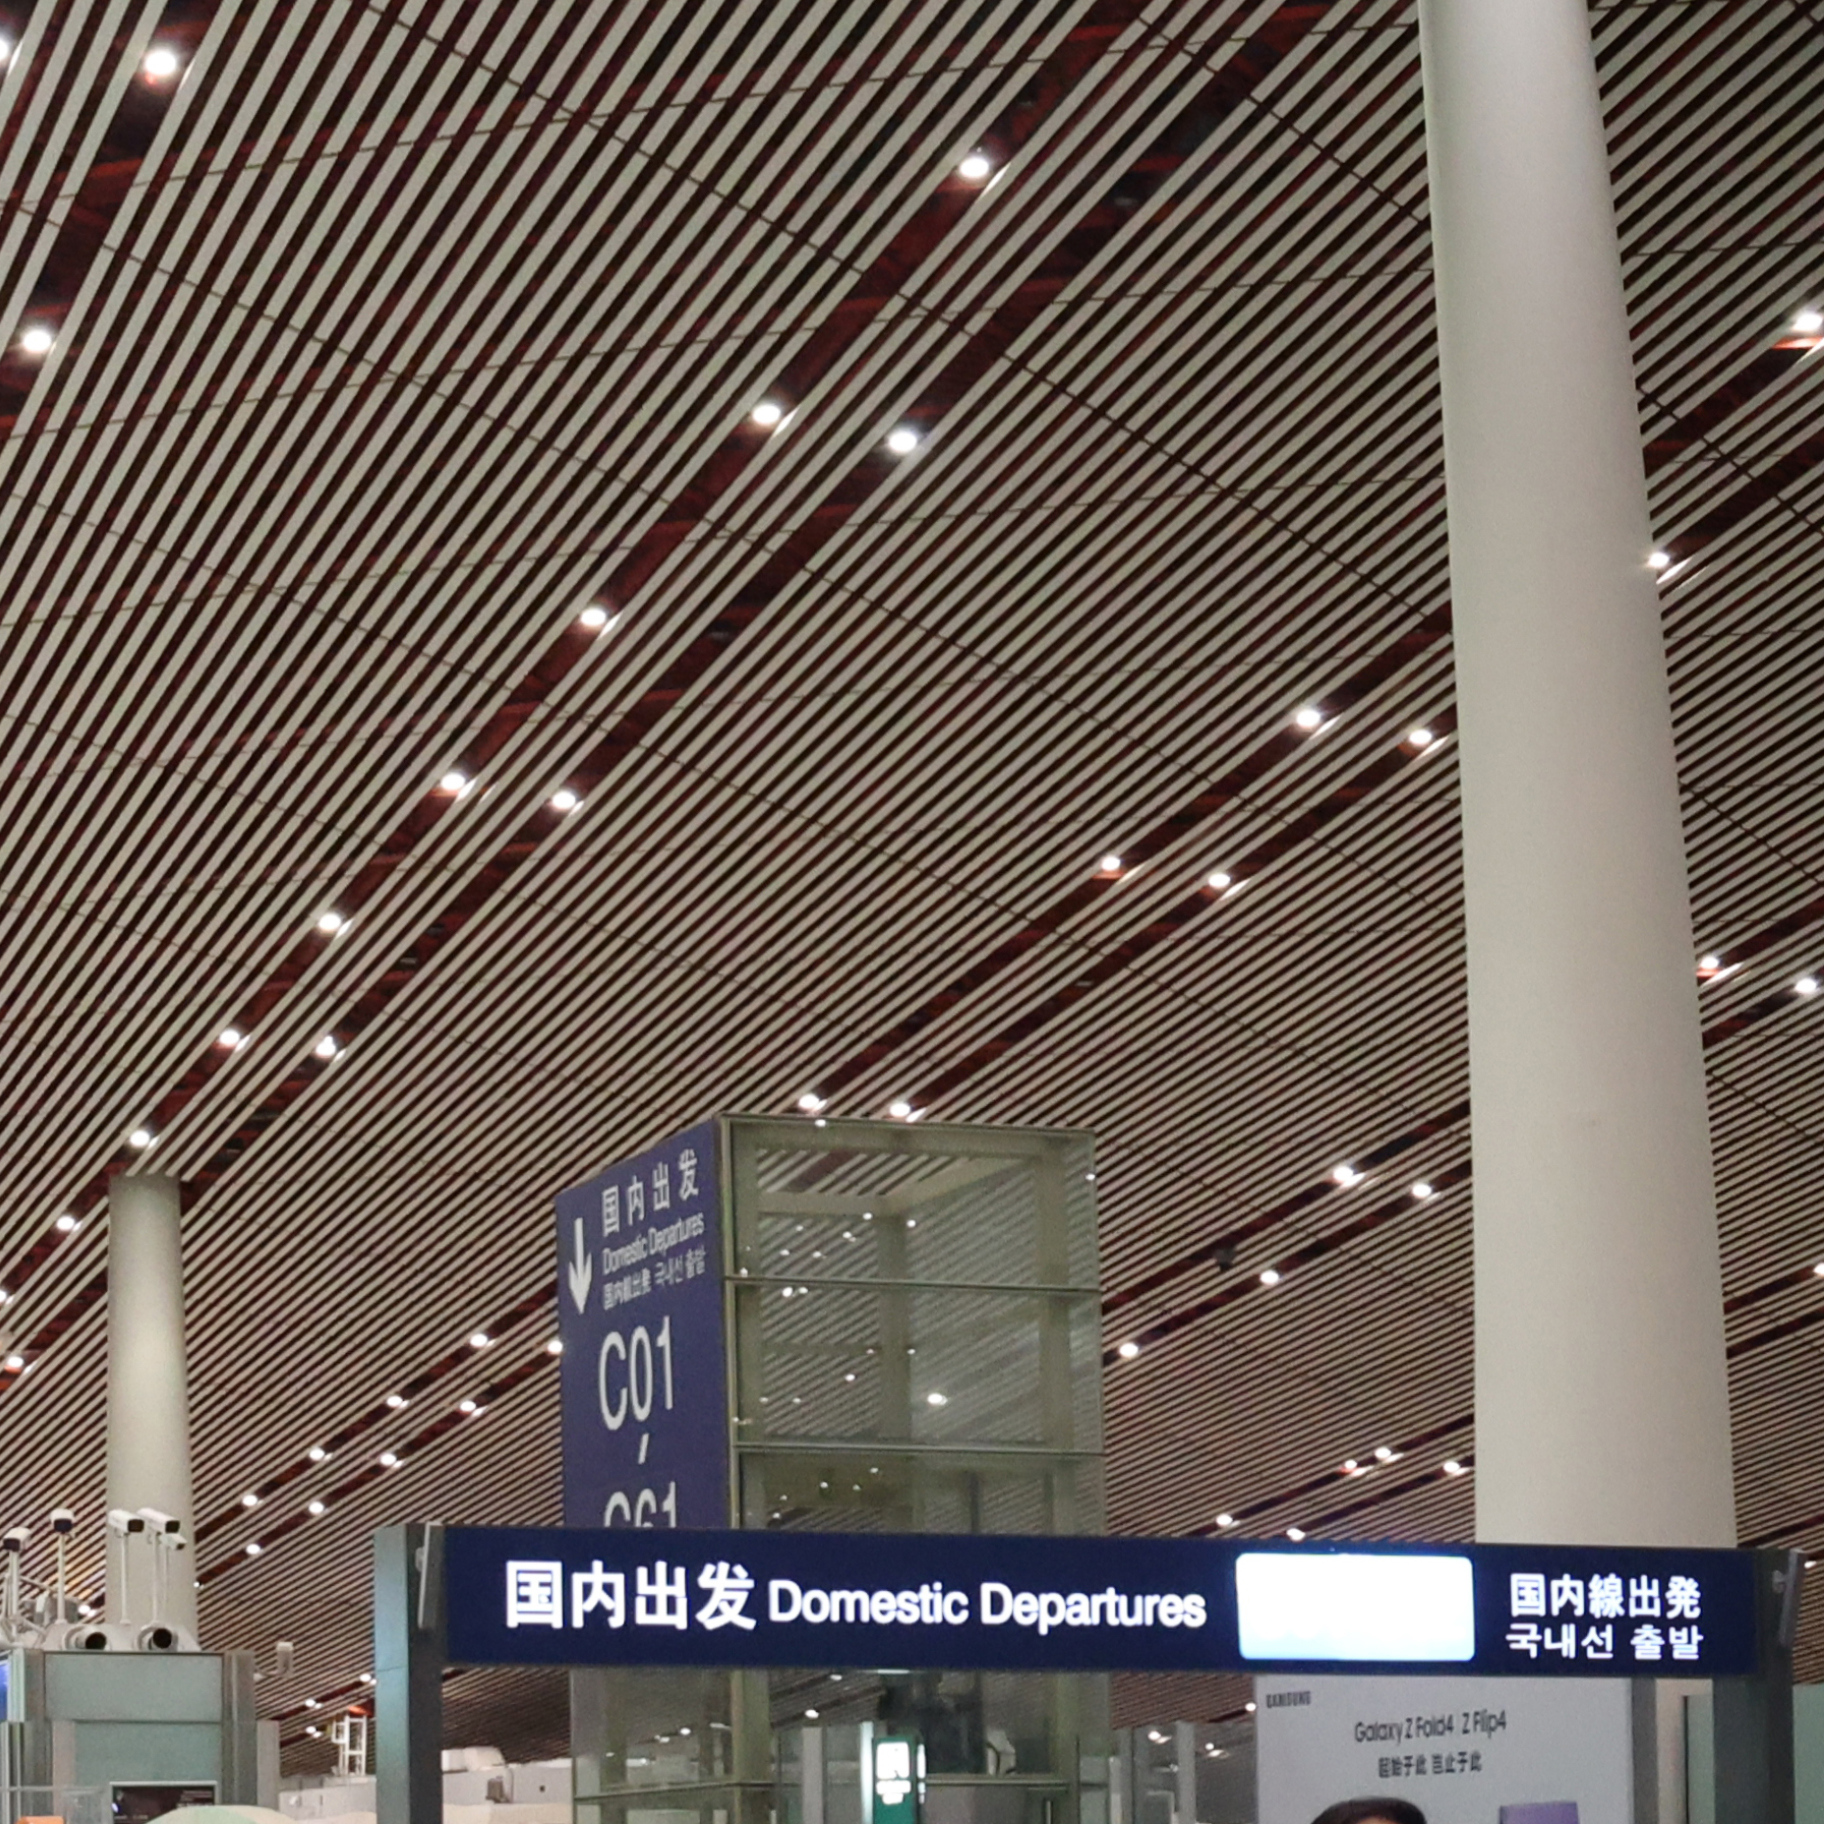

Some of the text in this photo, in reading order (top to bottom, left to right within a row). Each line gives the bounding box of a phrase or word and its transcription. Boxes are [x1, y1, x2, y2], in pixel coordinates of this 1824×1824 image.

[602, 1149, 698, 1237] 国内出发
[602, 1212, 705, 1275] Domestic Departures
[599, 1315, 673, 1431] C01
[505, 1560, 756, 1630] 国内出发
[768, 1580, 1207, 1635] Domestic Departures
[1510, 1572, 1701, 1619] 国内線出発
[1505, 1623, 1704, 1660] 국내선 출발
[1354, 1710, 1507, 1746] Galaxy Z Fold4 Z Flip4
